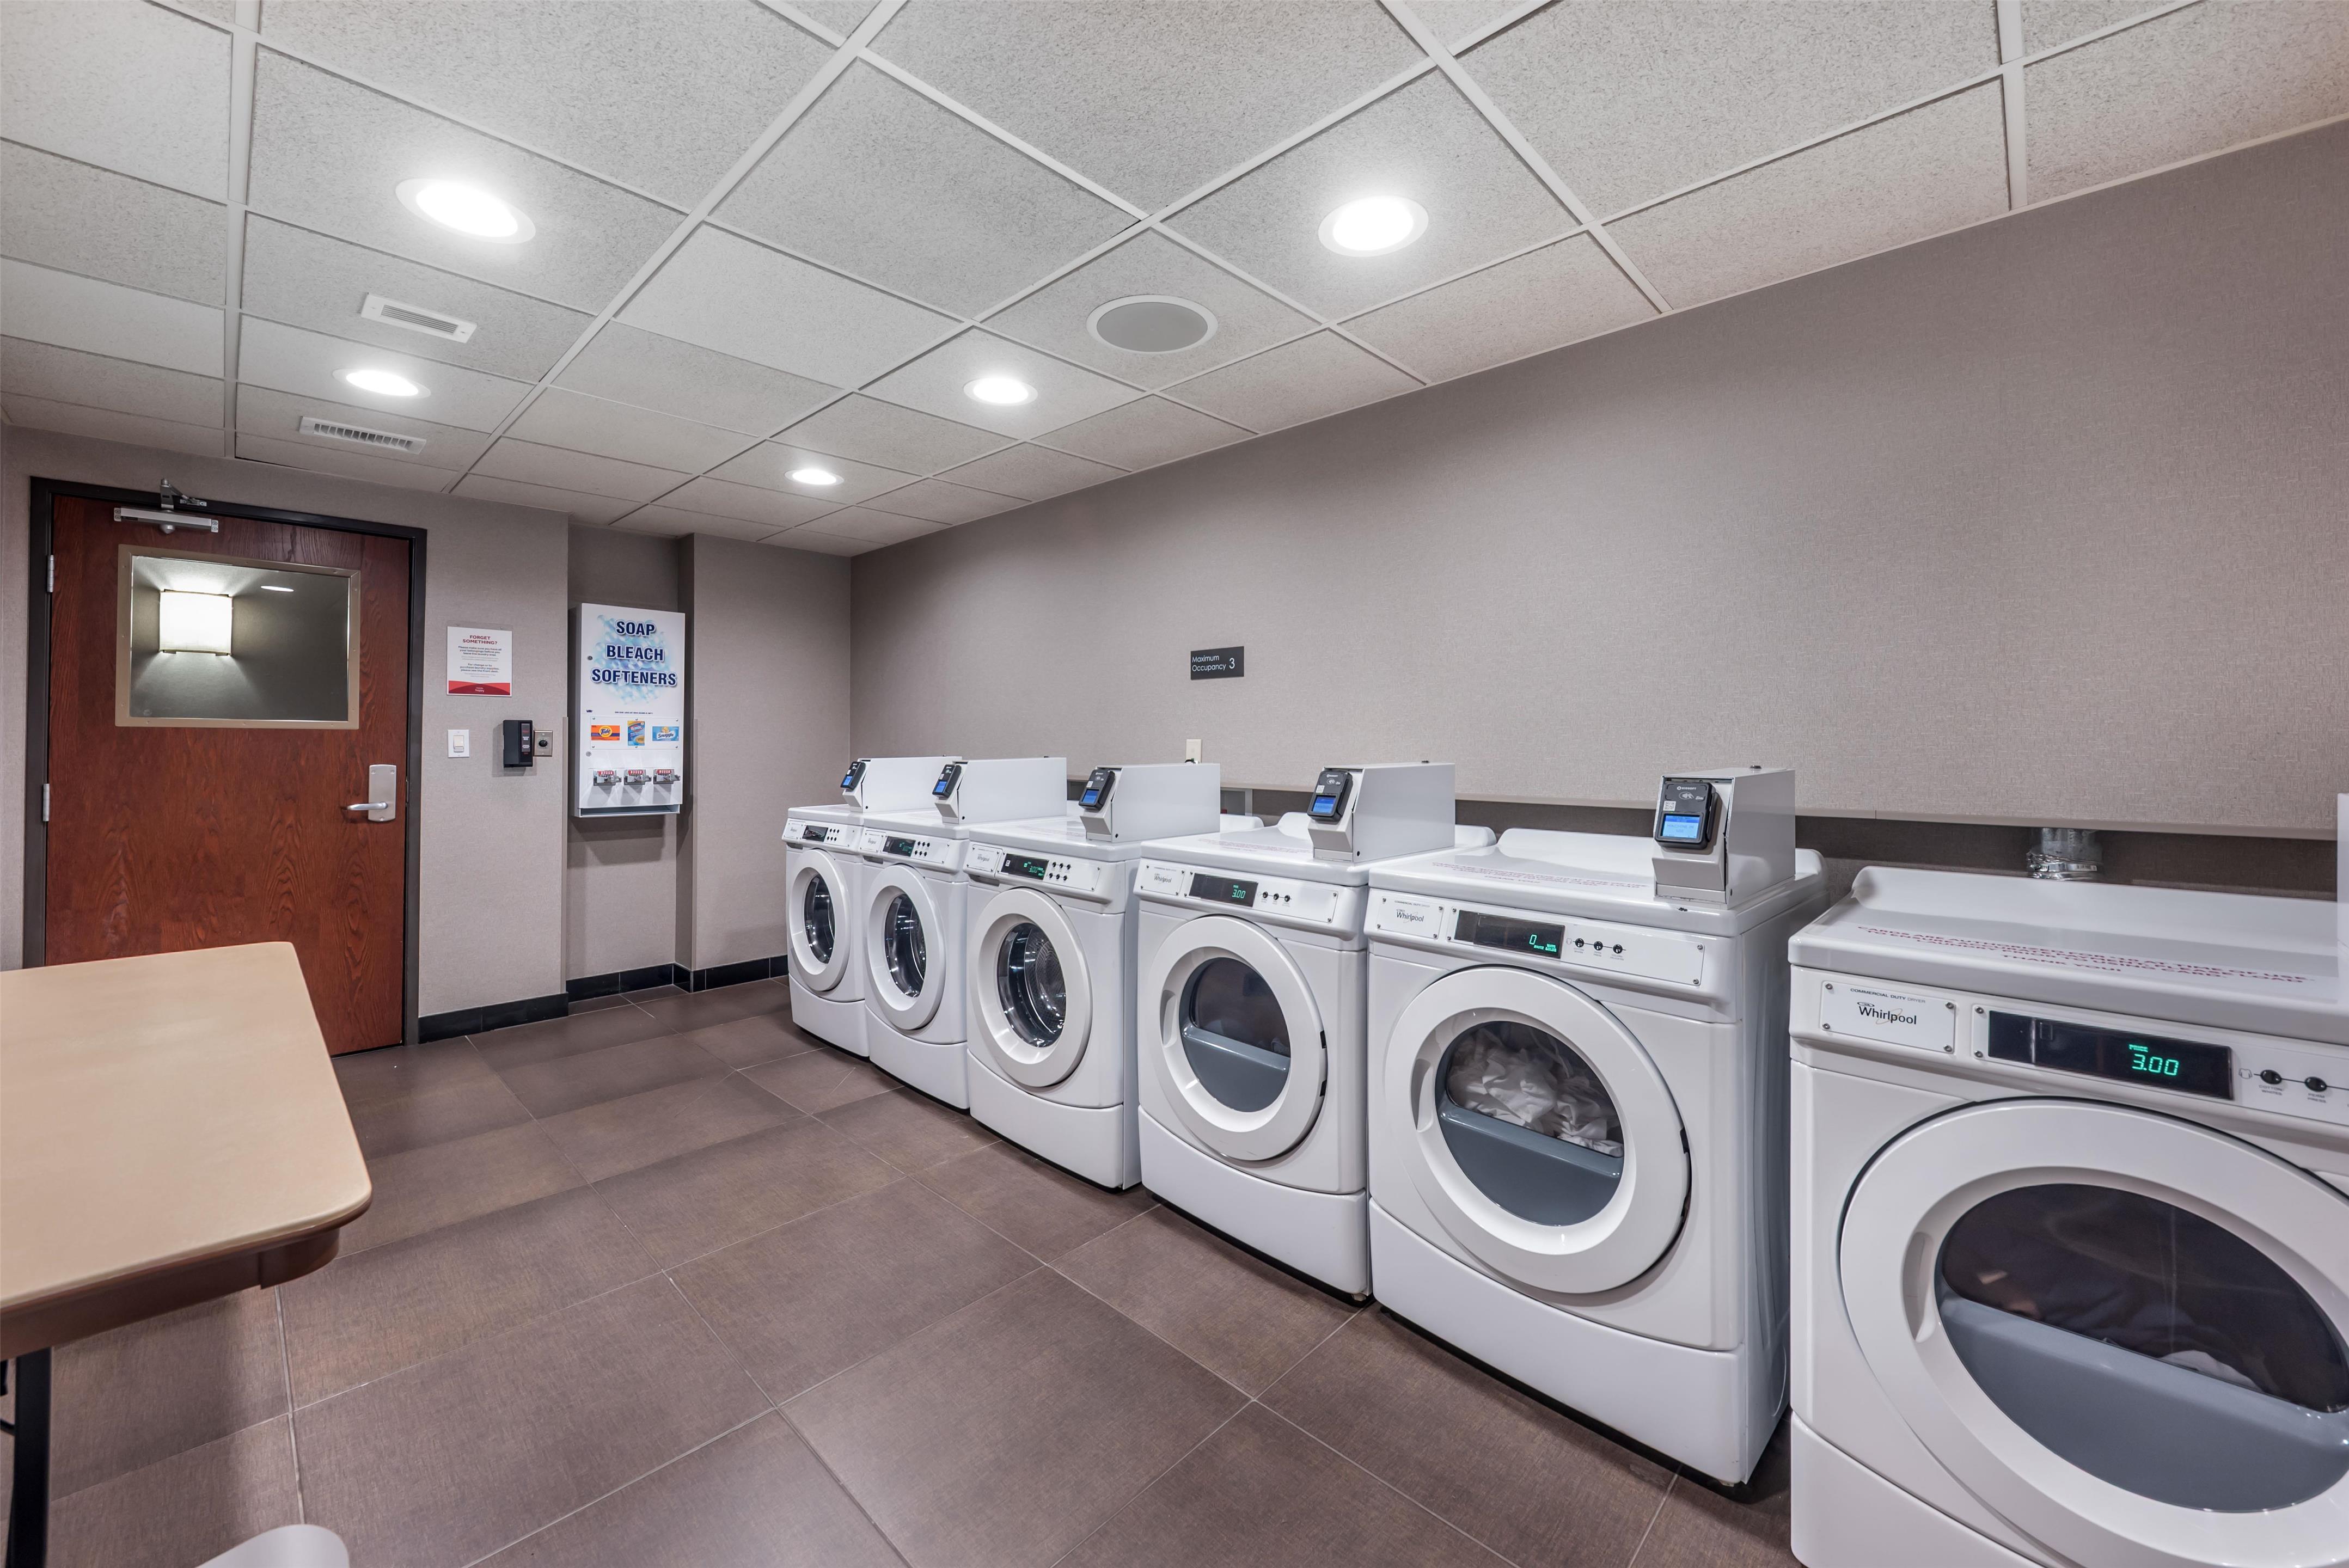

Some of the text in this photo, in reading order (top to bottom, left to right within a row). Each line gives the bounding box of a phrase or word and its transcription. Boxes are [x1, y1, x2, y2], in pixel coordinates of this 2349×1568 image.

[616, 621, 655, 635] SOAP
[607, 645, 663, 661] BLEACH
[1192, 664, 1226, 672] Occupancy
[1229, 658, 1235, 669] 3
[592, 669, 676, 685] SOFTENERS
[1396, 911, 1424, 922] Whirlpool
[1529, 934, 1537, 945] 0
[1850, 988, 1889, 997] COMMERCIAL
[1859, 1006, 1917, 1025] Whirlpool
[2132, 1054, 2179, 1076] 3.00
